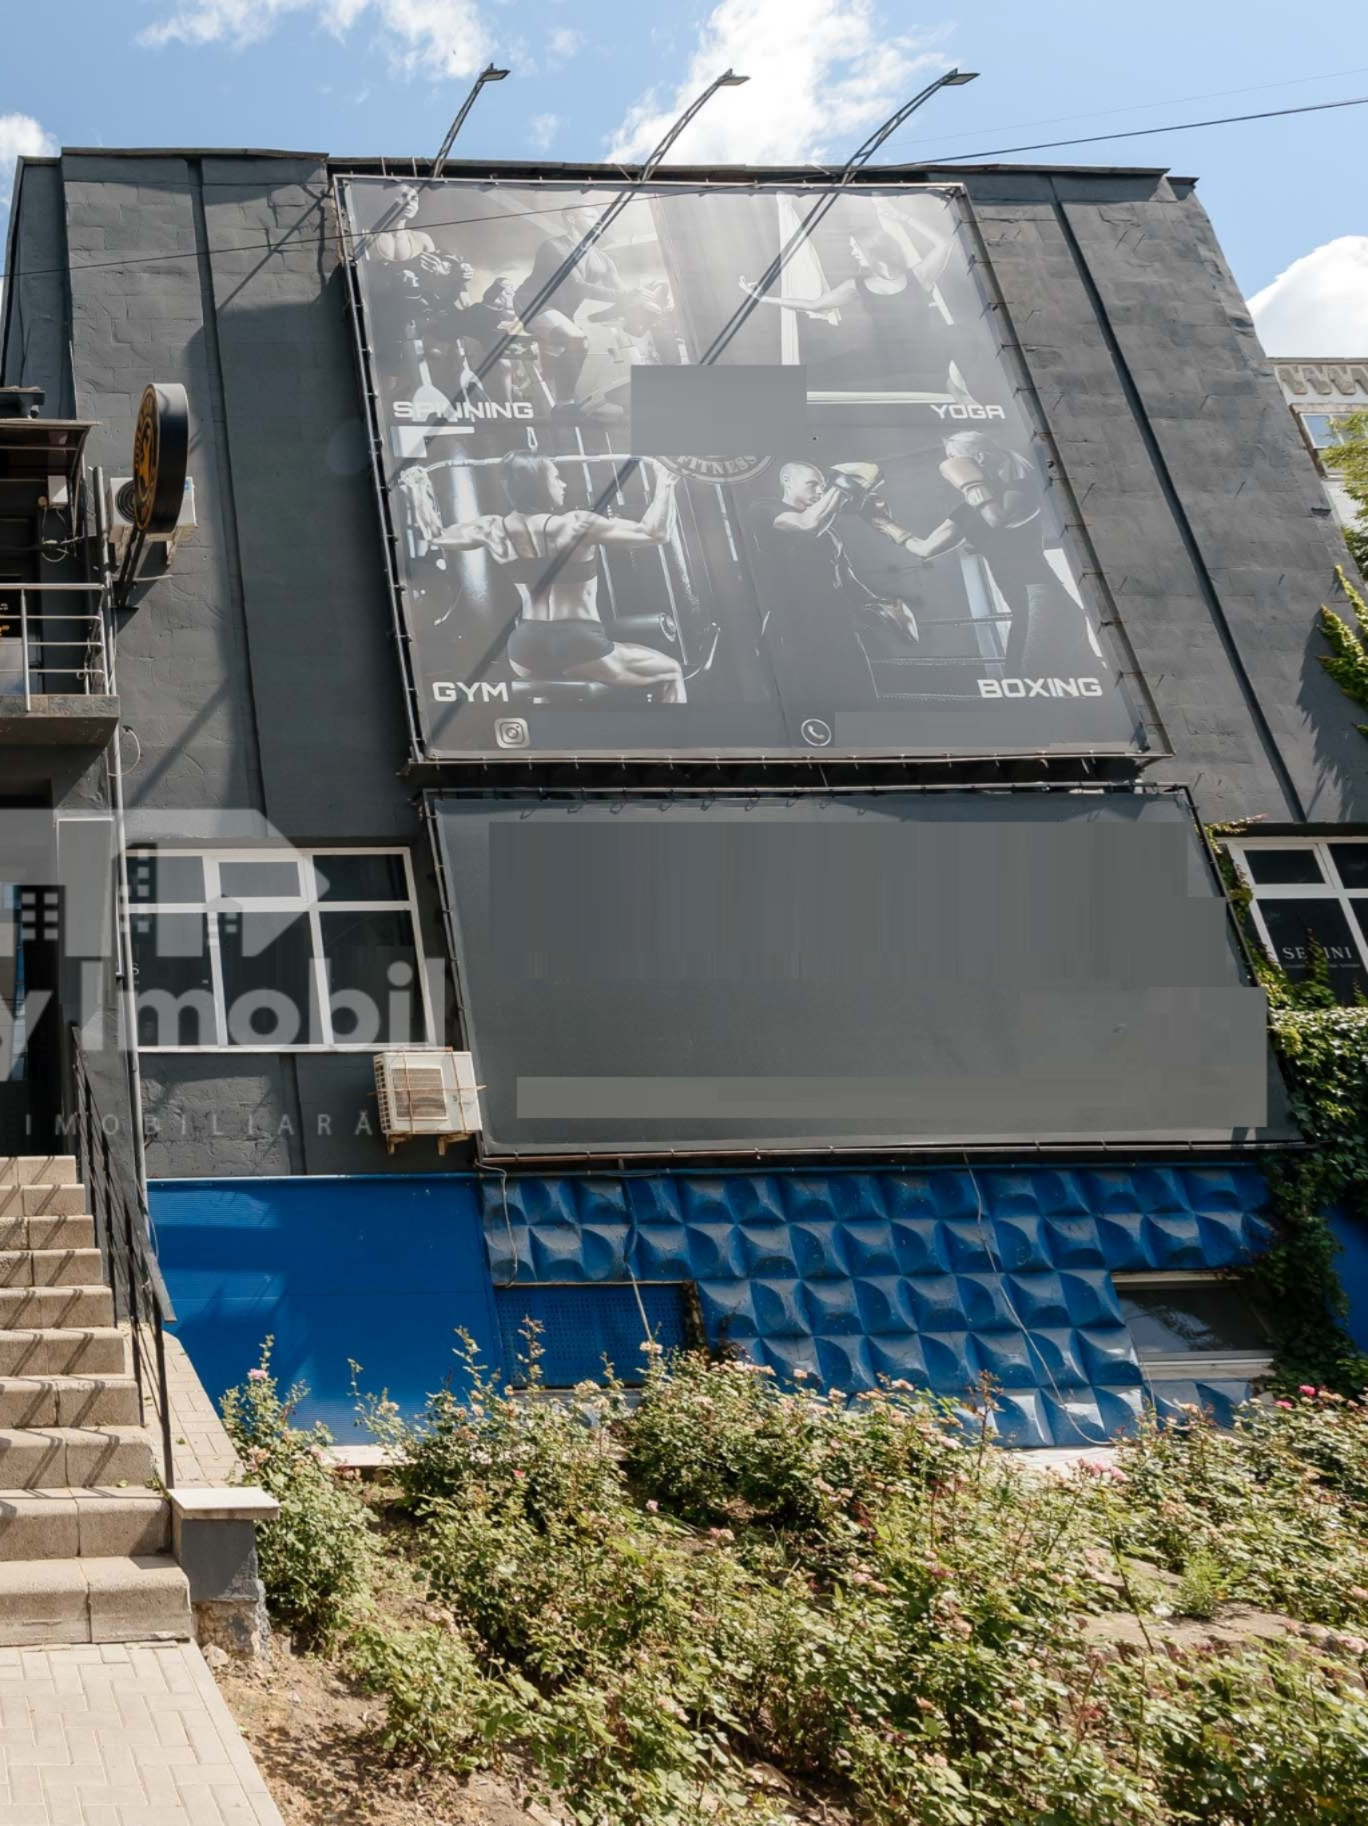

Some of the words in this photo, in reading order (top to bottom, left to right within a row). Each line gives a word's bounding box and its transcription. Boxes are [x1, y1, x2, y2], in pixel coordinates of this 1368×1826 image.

[929, 404, 1006, 419] YOGA
[432, 682, 509, 702] GYM
[977, 677, 1103, 698] BOXING
[1282, 946, 1352, 959] SEINI
